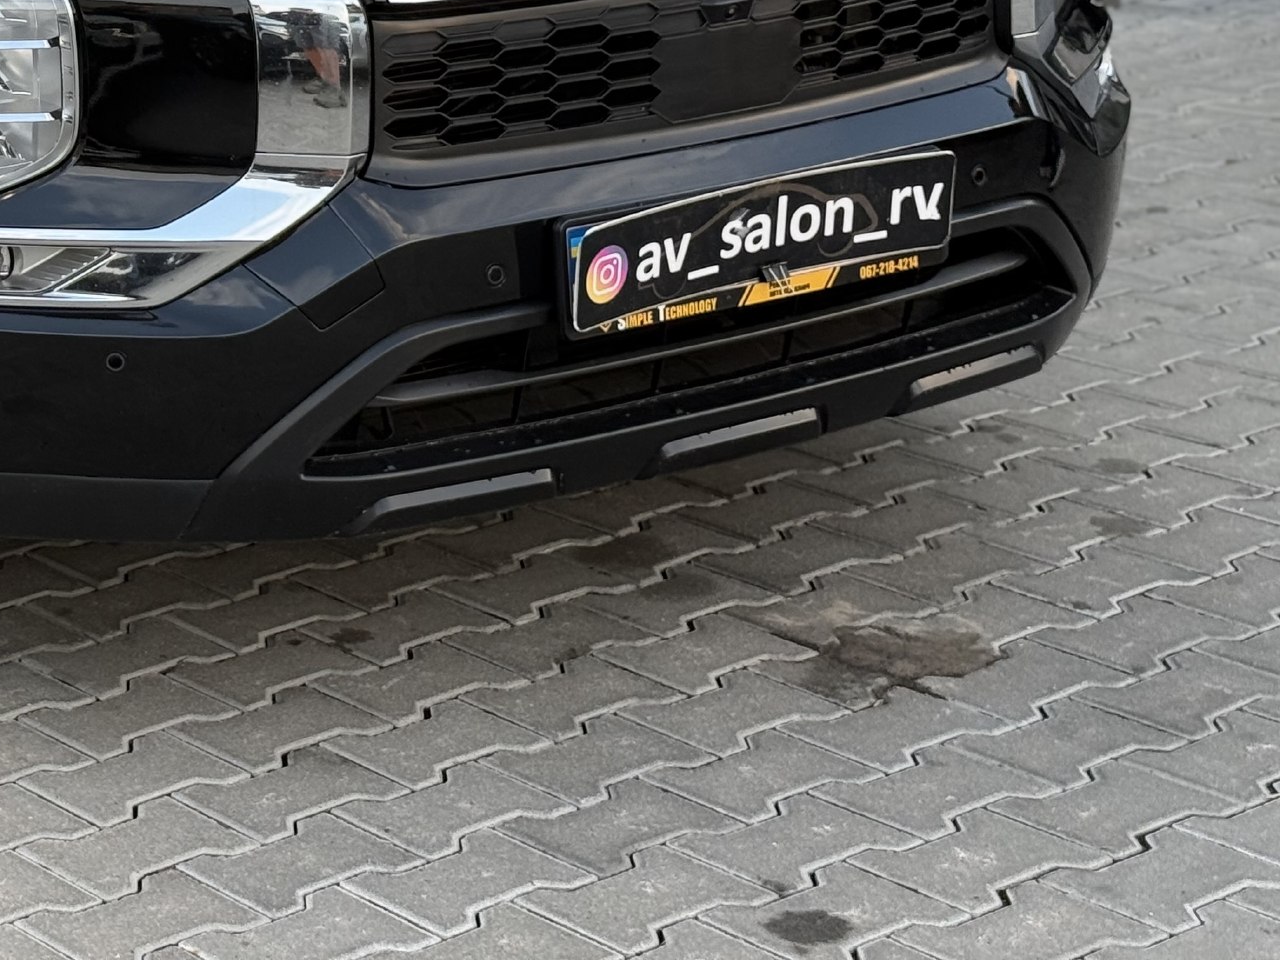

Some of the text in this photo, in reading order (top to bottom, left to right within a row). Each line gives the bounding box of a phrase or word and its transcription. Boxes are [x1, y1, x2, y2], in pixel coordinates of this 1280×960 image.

[635, 182, 944, 282] av_salon_rv
[617, 297, 718, 331] SIMPLE TECHNOLOGY
